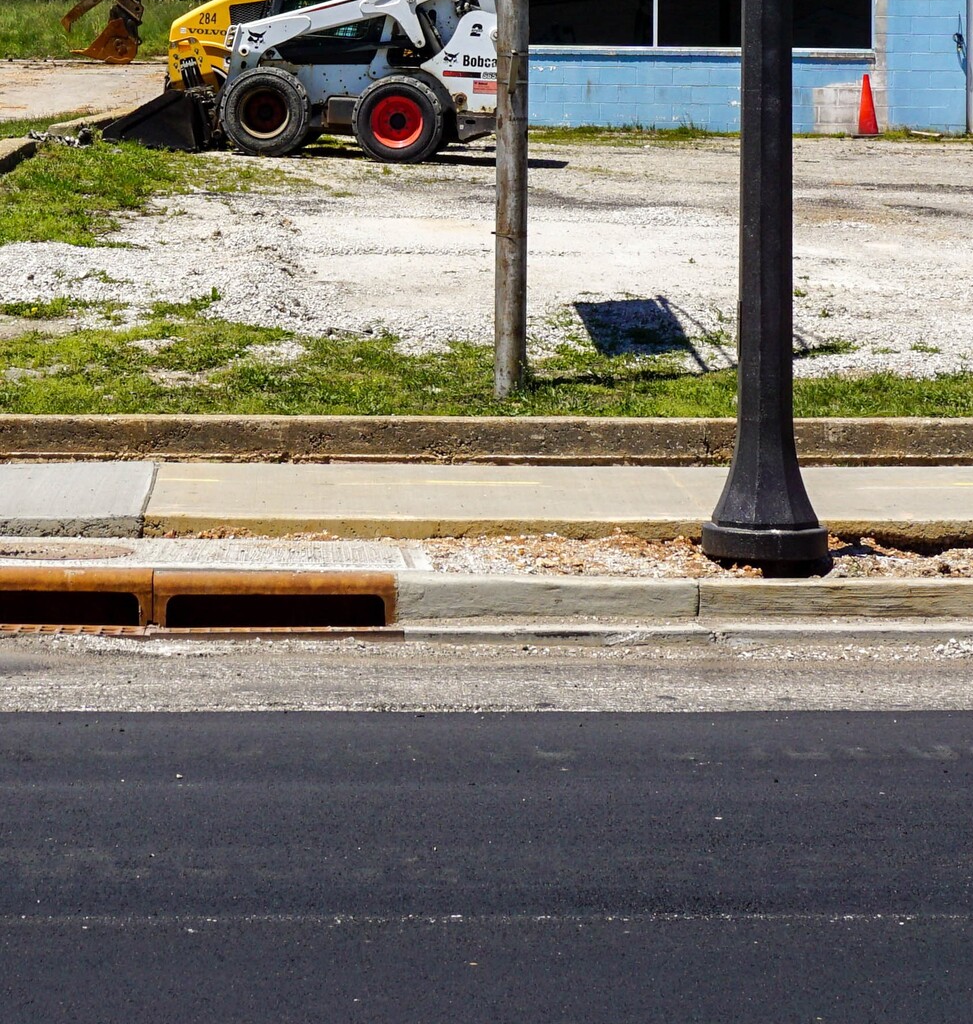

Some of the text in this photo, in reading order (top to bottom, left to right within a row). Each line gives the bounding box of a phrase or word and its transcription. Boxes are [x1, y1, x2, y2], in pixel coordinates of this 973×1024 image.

[199, 12, 217, 24] 284
[187, 28, 227, 36] VOLVO
[463, 55, 497, 67] Bobca
